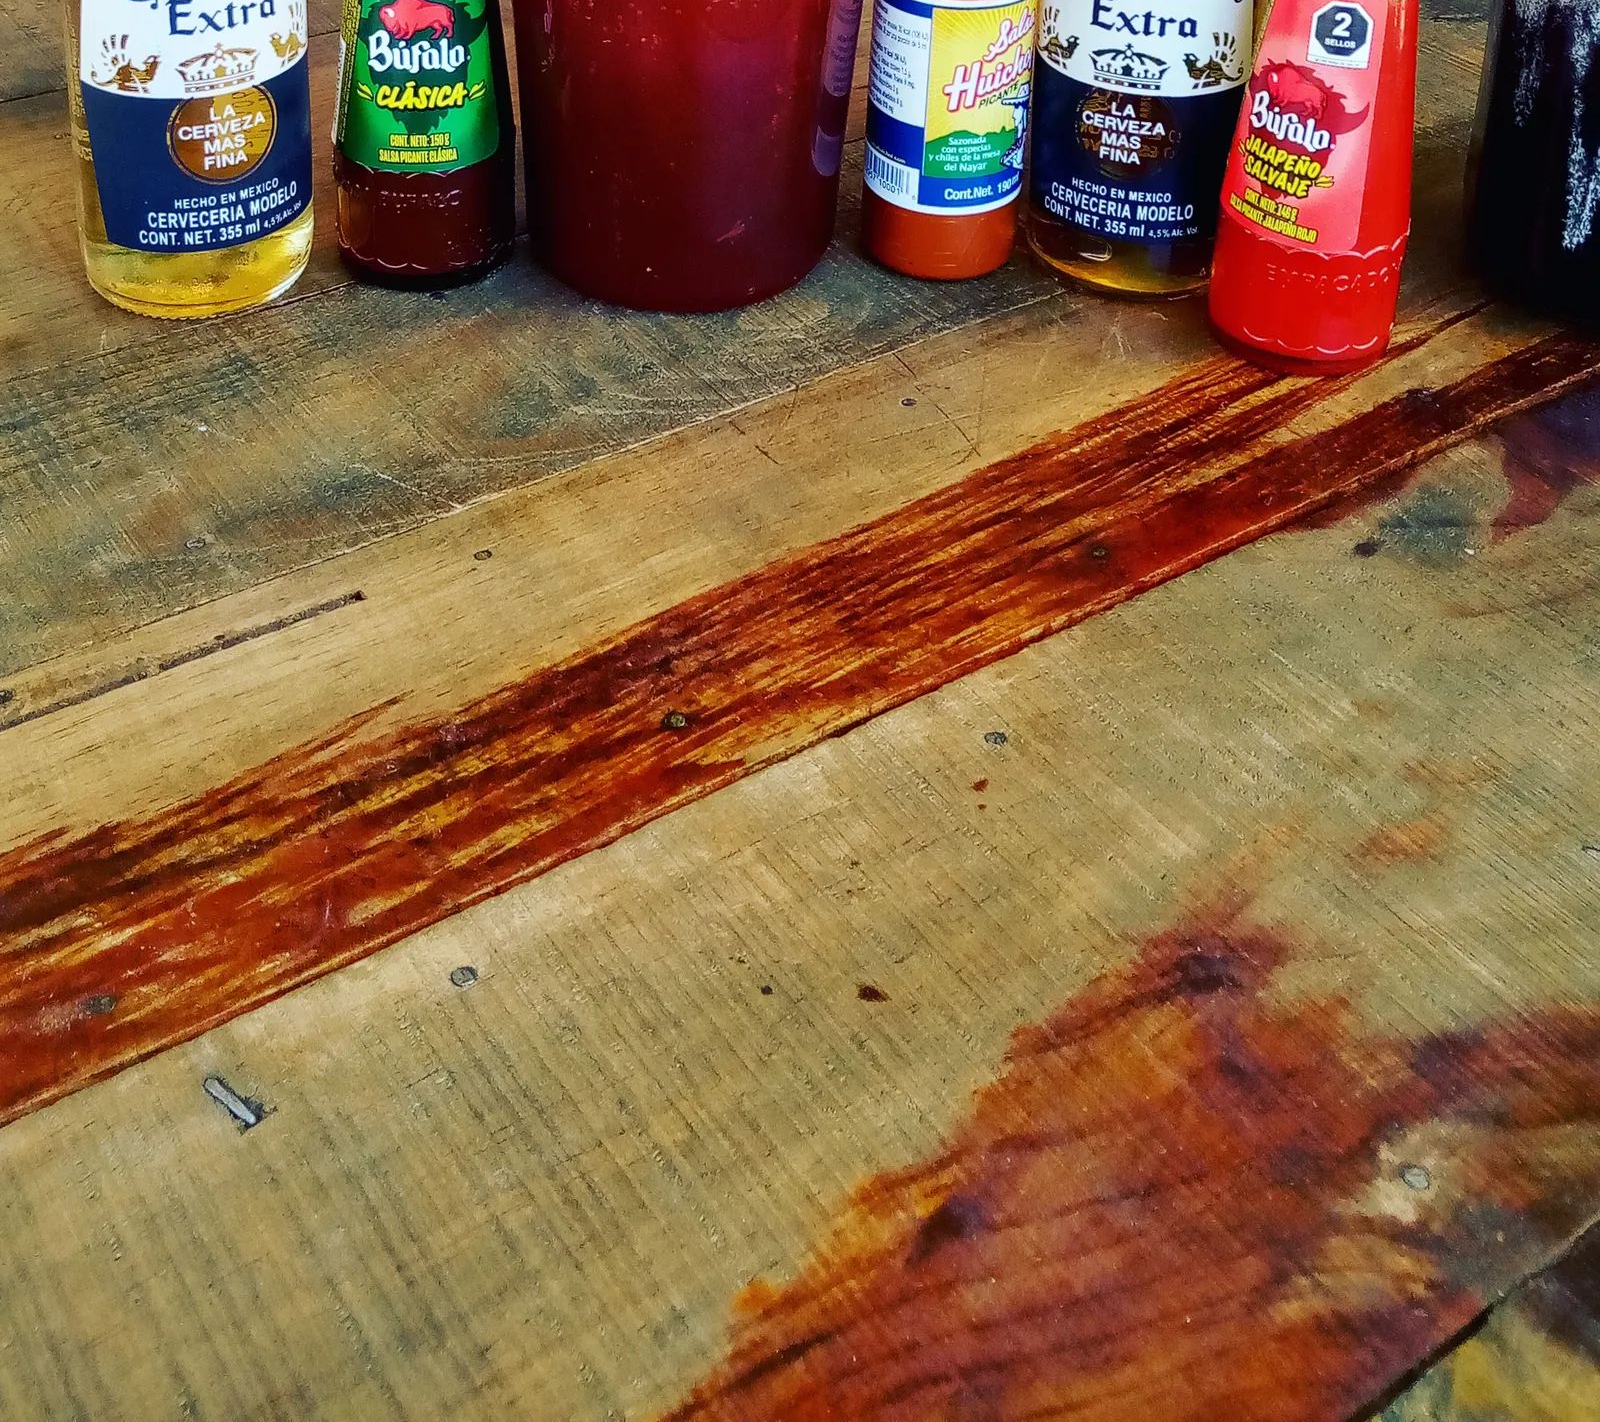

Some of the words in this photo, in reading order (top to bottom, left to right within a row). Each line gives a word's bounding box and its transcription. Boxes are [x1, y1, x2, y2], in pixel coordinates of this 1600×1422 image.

[1332, 12, 1353, 37] 2
[367, 29, 465, 73] Búfalo
[1324, 37, 1356, 49] SELLOS
[942, 44, 1033, 112] Huicho
[376, 81, 468, 109] CLÁSICA
[978, 79, 1019, 108] PICANTE
[209, 104, 236, 121] LA
[1110, 101, 1136, 118] LA
[1249, 90, 1331, 152] Búfalo
[178, 111, 266, 141] CERVEZA
[1082, 110, 1166, 136] CERVEZA
[203, 133, 246, 154] MAS
[390, 134, 409, 147] CONT.
[430, 133, 444, 146] 150
[948, 137, 987, 145] Sazonada
[958, 144, 991, 154] especias
[1101, 130, 1142, 150] MAS
[204, 150, 248, 171] FINA
[379, 149, 400, 163] SALSA
[401, 150, 429, 163] PICANTE
[429, 146, 458, 162] CLÁSICA
[935, 153, 959, 162] chiles
[961, 153, 971, 162] de
[982, 150, 1001, 159] mesa
[1099, 145, 1141, 165] FINA
[1246, 134, 1321, 178] JALAPEÑO
[944, 163, 957, 171] del
[959, 162, 987, 173] Nayar
[1245, 155, 1312, 197] SALVAJE
[174, 196, 217, 209] HECHO
[220, 192, 236, 205] EN
[239, 178, 279, 200] MEXICO
[997, 178, 1011, 193] 190
[1072, 177, 1107, 196] HECHO
[1110, 188, 1125, 200] EN
[1128, 191, 1171, 203] MEXICO
[148, 204, 246, 228] CERVECERIA
[250, 181, 297, 216] MODELO
[1051, 181, 1132, 219] CERVECERIA
[1136, 204, 1194, 222] MODELO
[1277, 203, 1291, 219] 146
[1044, 195, 1072, 221] CONT.
[1074, 210, 1100, 230] NET.
[1104, 219, 1126, 235] 355
[1129, 224, 1145, 237] ml
[139, 230, 181, 246] CONT.
[184, 230, 216, 245] NET.
[219, 224, 243, 241] 355
[246, 218, 260, 235] ml
[1263, 215, 1297, 237] JALAPEÑO
[1297, 226, 1317, 243] ROJO
